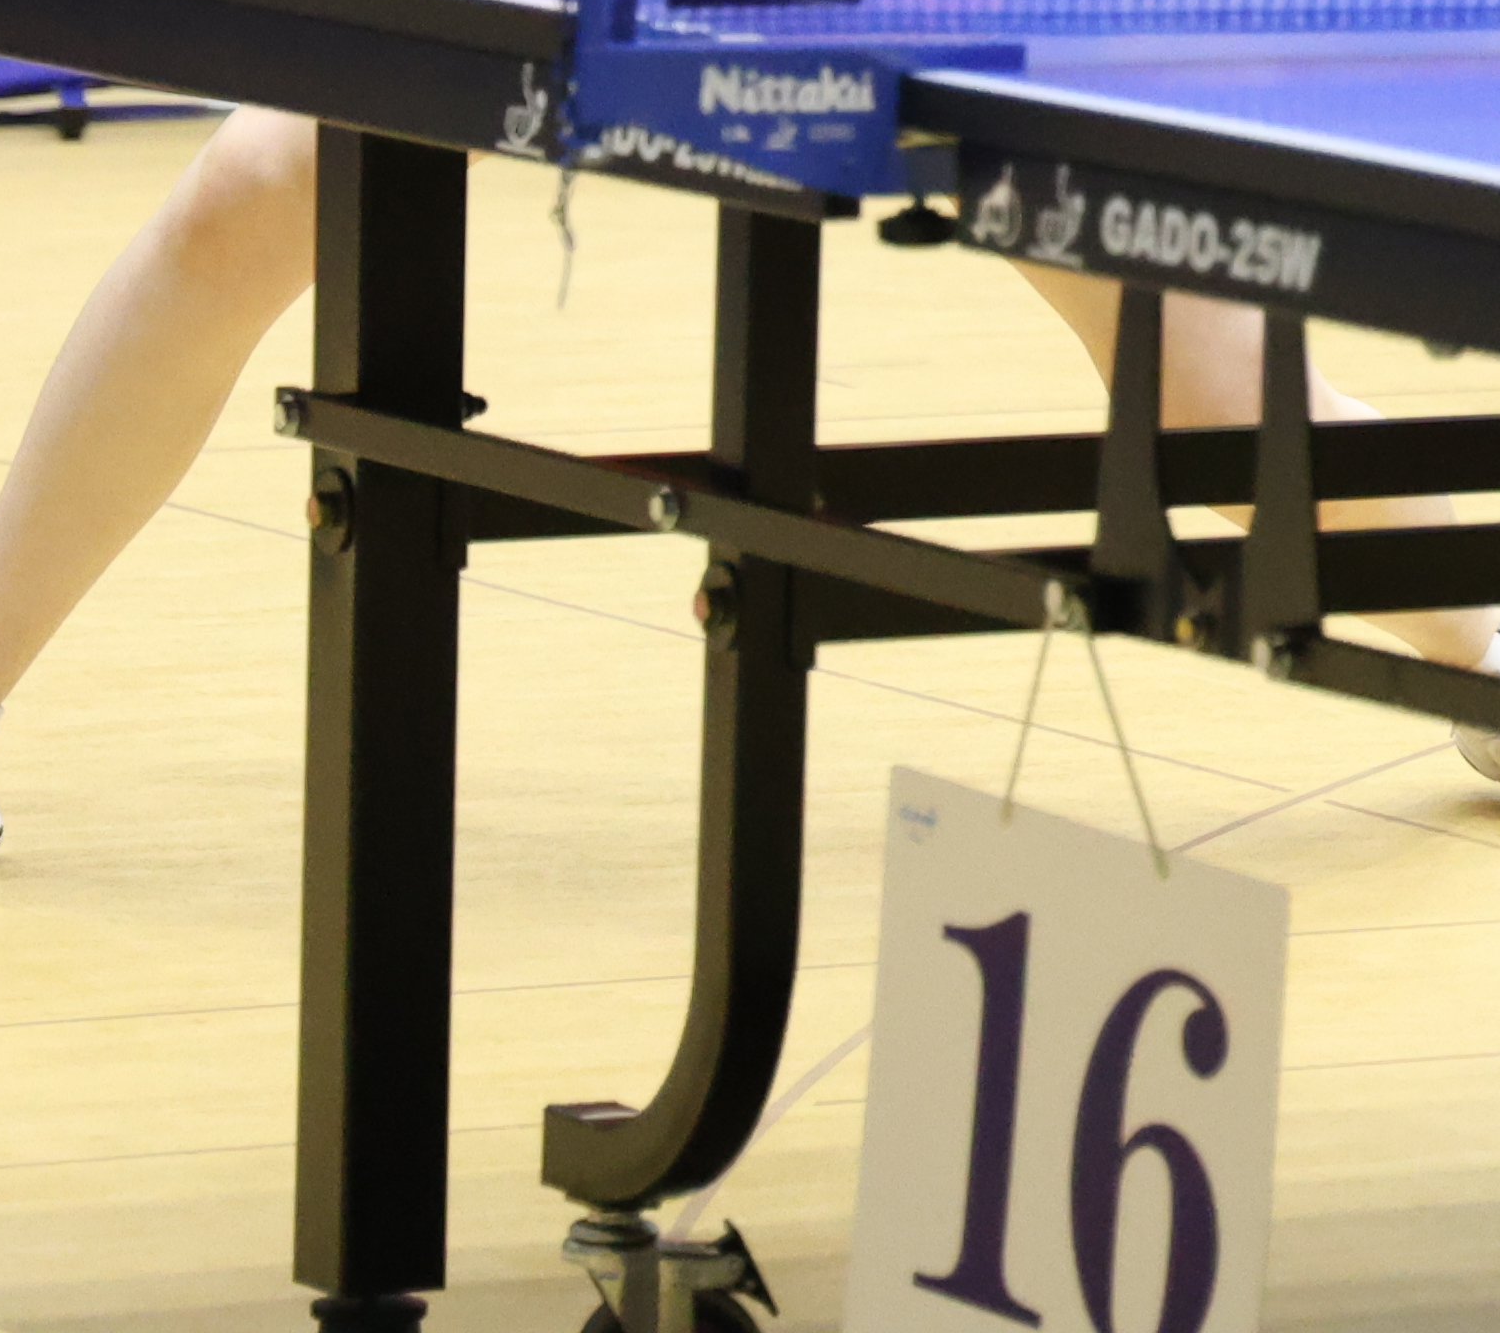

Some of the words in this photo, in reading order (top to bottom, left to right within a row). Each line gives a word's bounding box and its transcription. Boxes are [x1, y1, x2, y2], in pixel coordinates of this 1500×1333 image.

[700, 64, 874, 115] Nittaku
[1100, 195, 1322, 292] GADO-25W
[913, 910, 1230, 1333] 16
